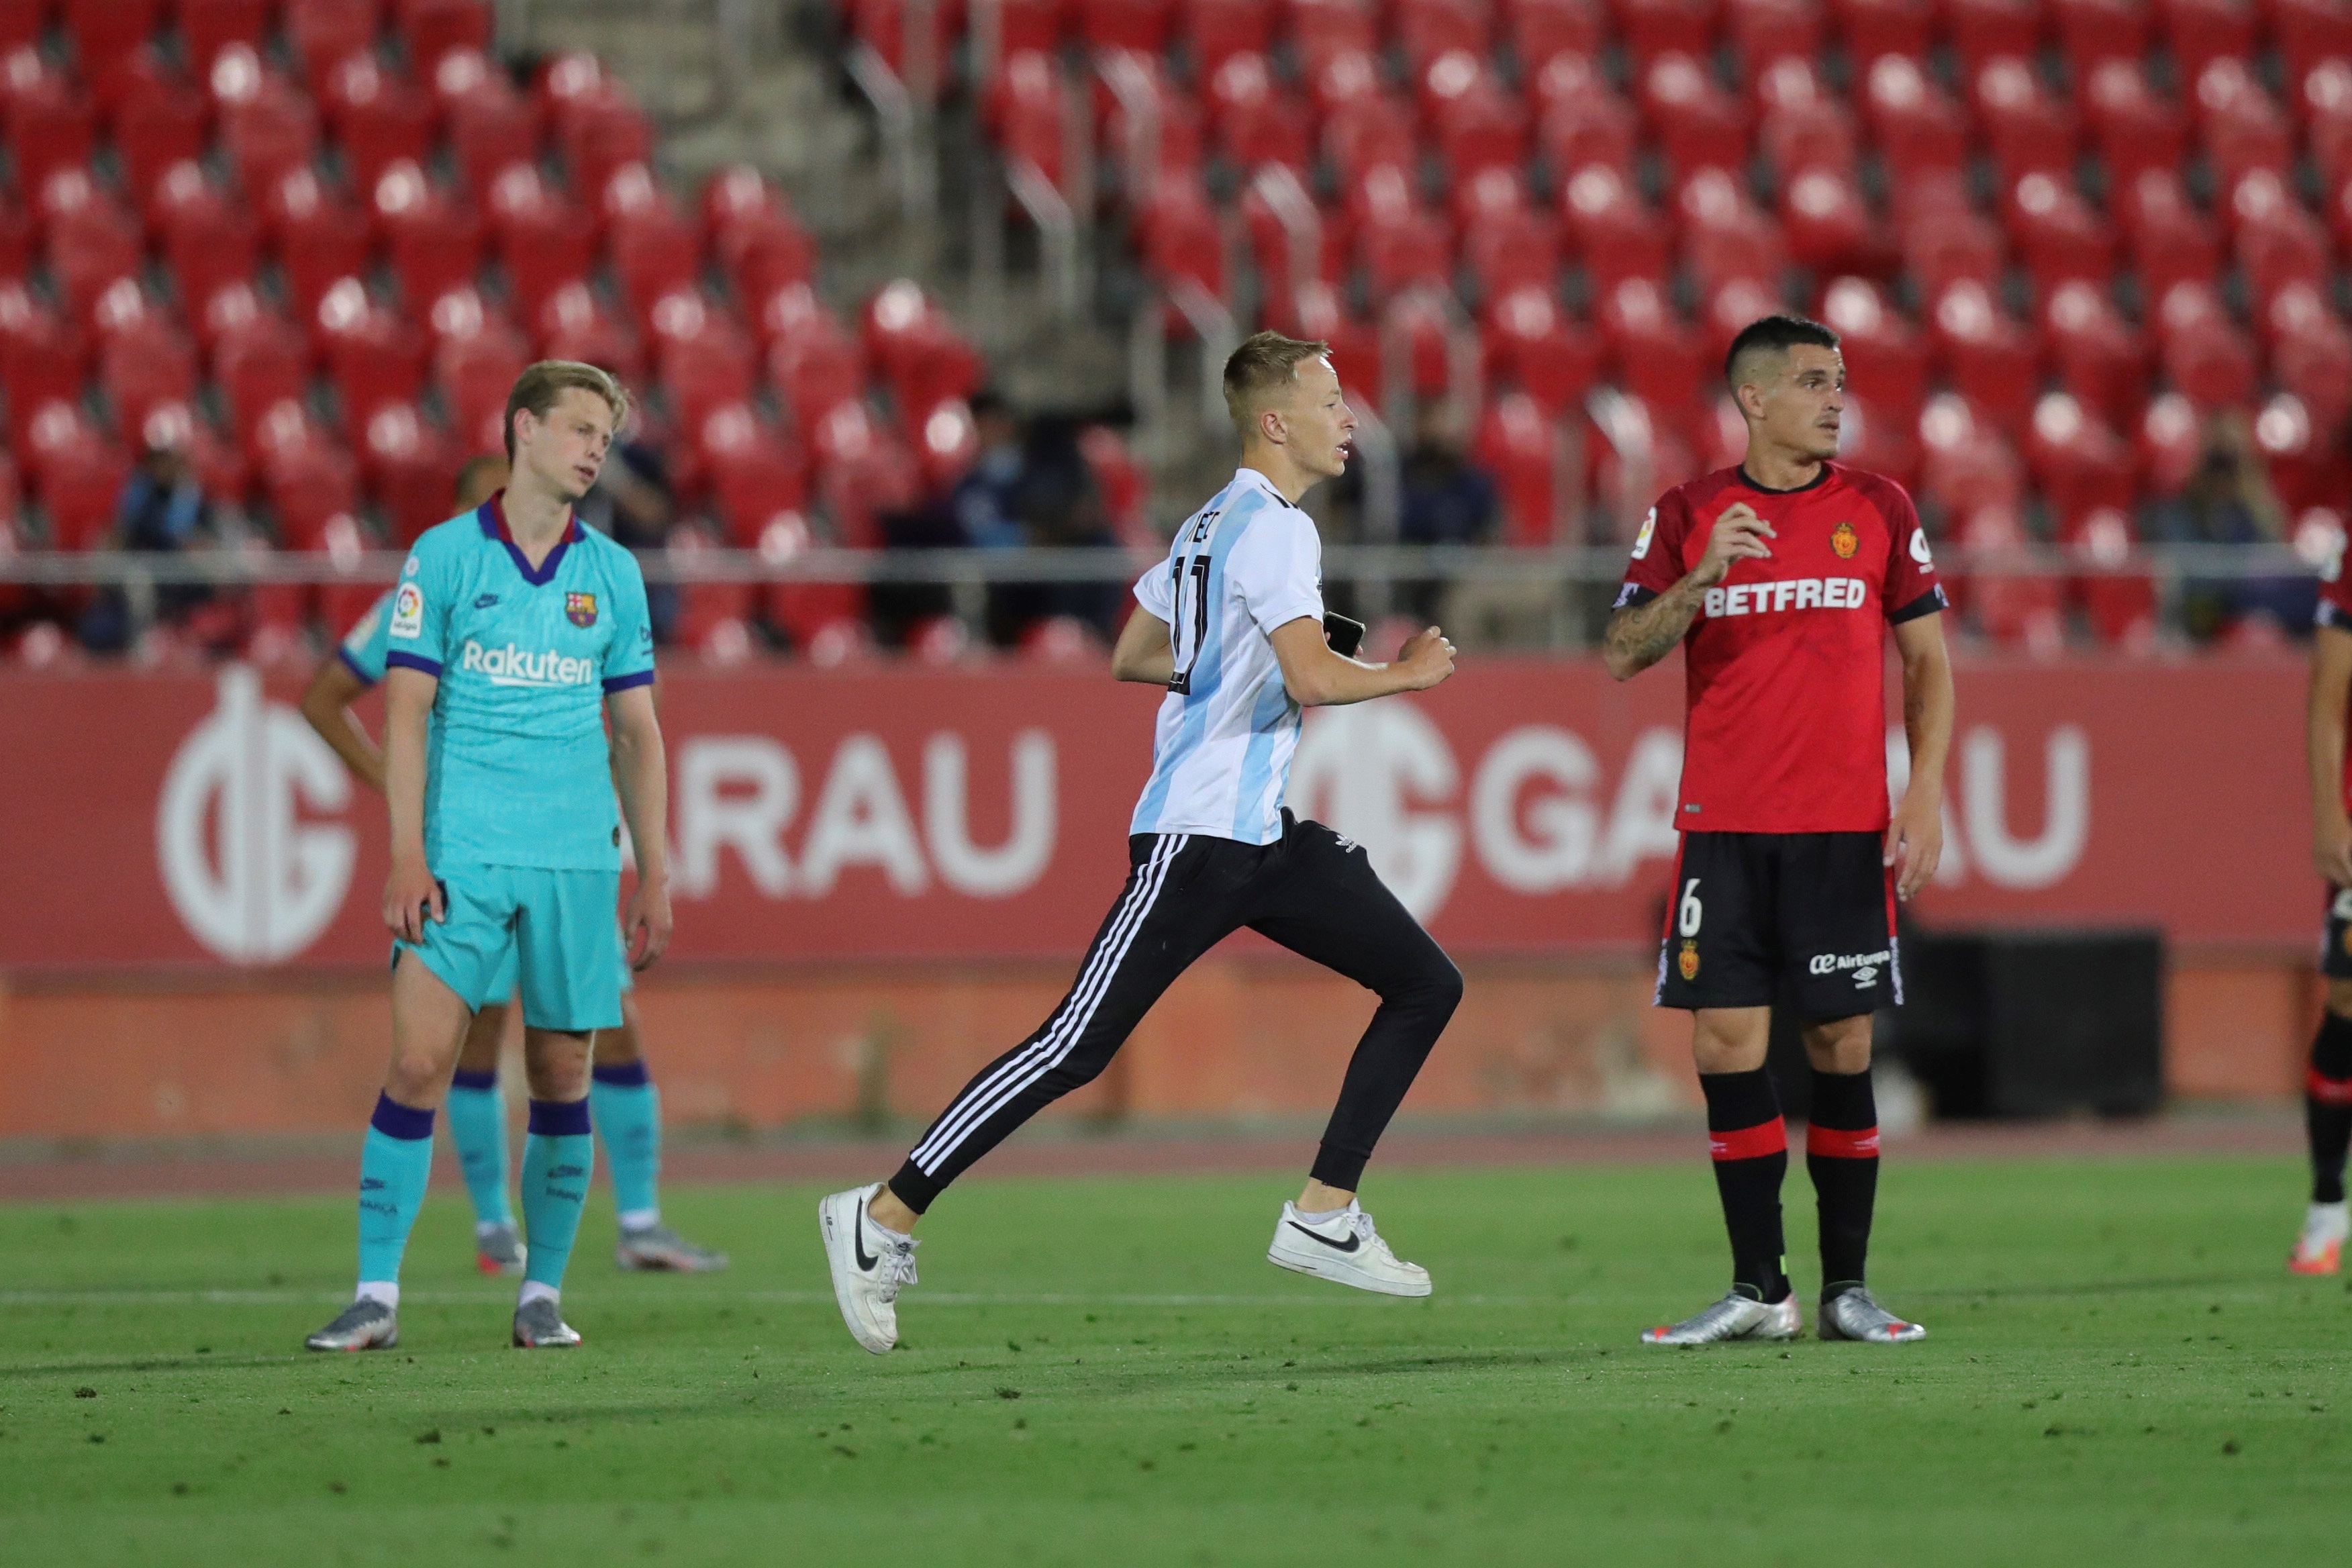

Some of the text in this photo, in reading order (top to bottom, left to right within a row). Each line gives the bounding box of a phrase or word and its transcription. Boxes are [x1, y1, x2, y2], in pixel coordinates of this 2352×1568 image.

[1704, 577, 1866, 618] BETFRED
[463, 640, 592, 685] Rakuten
[665, 726, 1058, 901] RAU
[1470, 721, 2092, 897] GAU
[1679, 878, 1703, 938] 6
